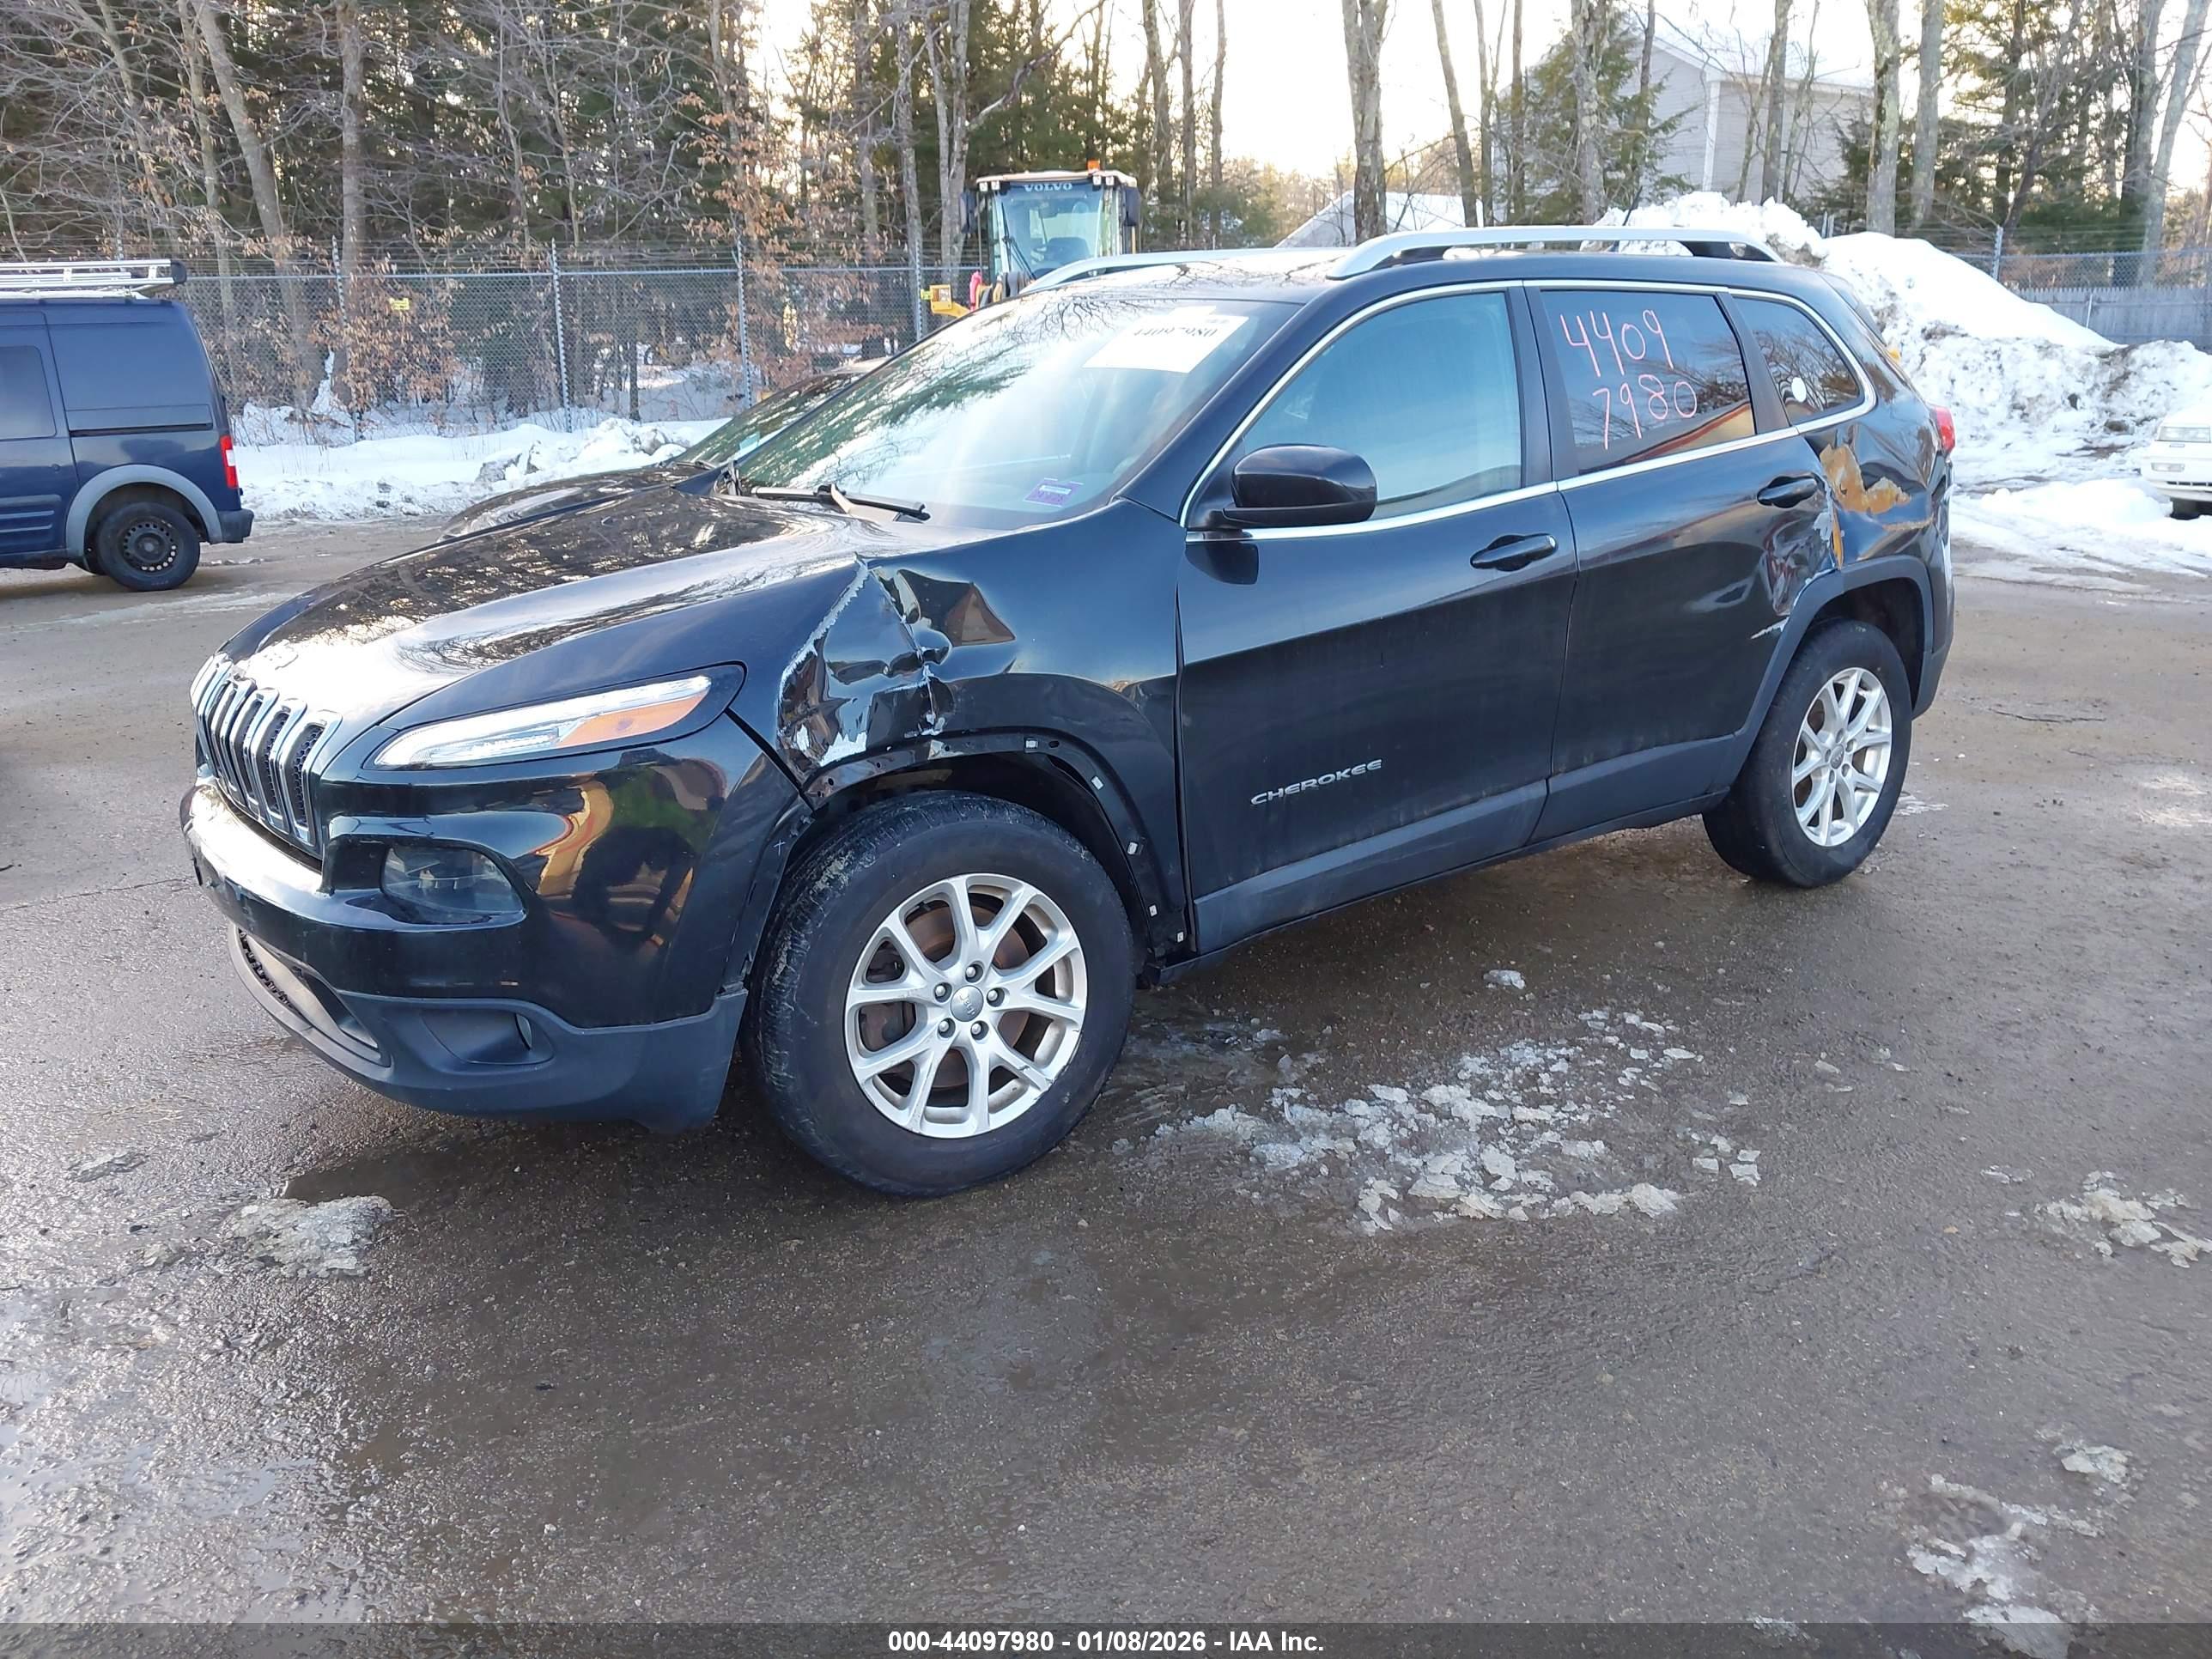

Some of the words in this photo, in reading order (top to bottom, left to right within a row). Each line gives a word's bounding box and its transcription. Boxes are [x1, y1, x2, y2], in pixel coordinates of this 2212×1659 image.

[1024, 182, 1073, 192] VOLVO
[1559, 309, 1674, 378] 4409
[1591, 374, 1698, 451] 7980
[1250, 758, 1382, 805] CHEROKEE
